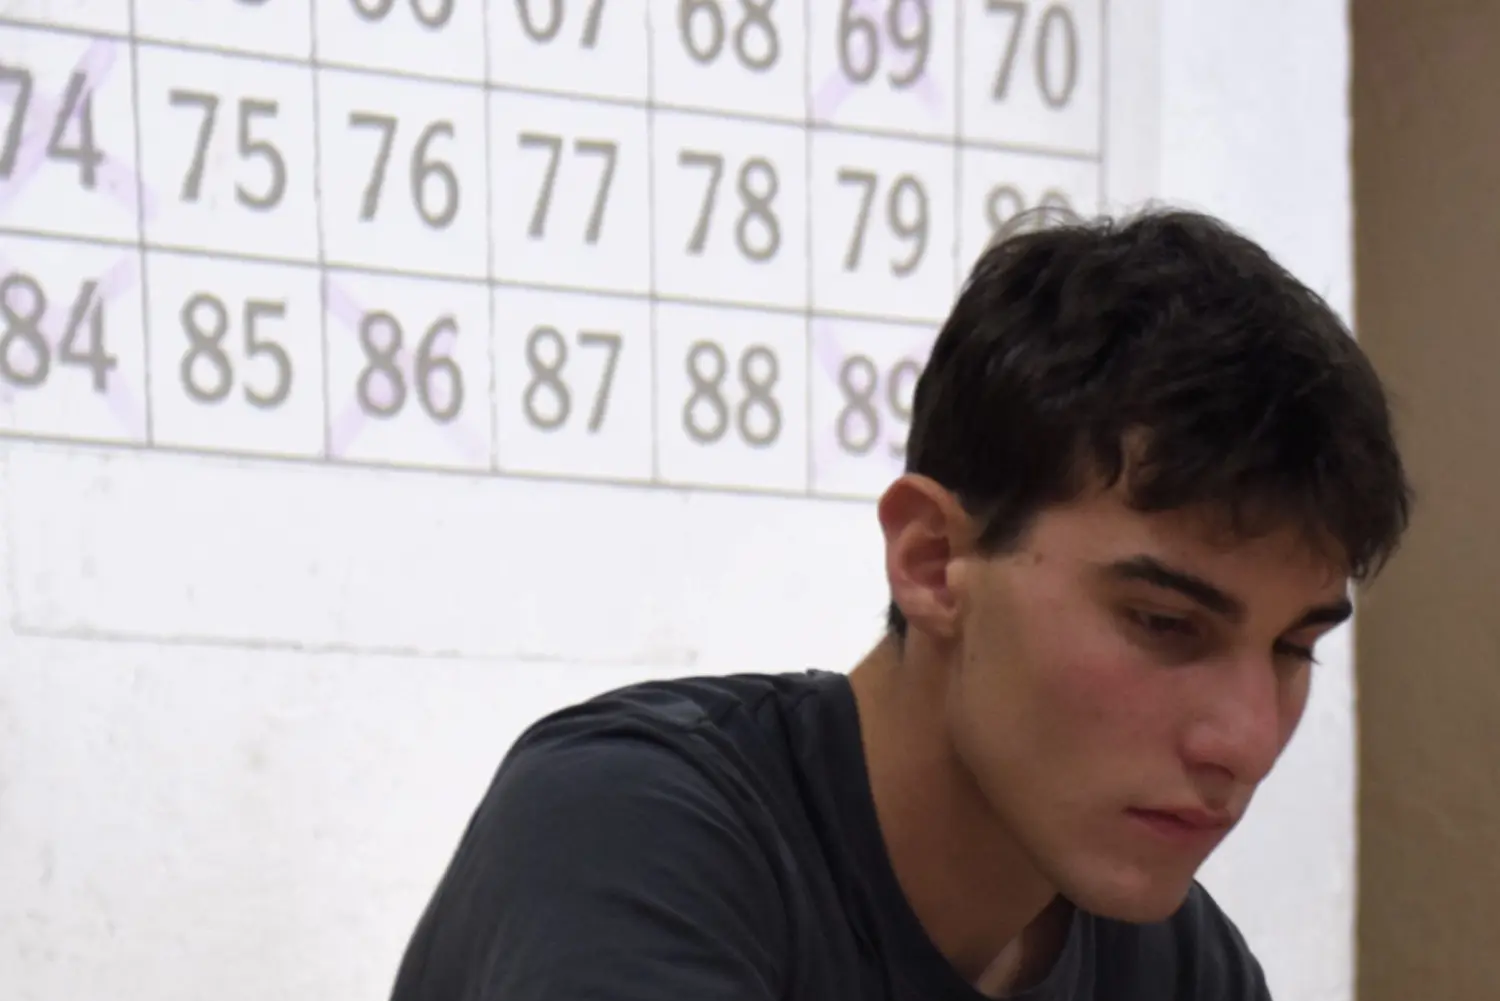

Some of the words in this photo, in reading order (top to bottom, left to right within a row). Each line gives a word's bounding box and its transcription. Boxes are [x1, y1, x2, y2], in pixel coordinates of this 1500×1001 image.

[677, 0, 781, 72] 68
[836, 0, 933, 90] 69
[984, 0, 1080, 110] 70
[0, 62, 107, 190] 74
[168, 89, 288, 212] 75
[348, 112, 460, 230] 76
[518, 133, 618, 244] 77
[678, 150, 782, 263] 78
[836, 167, 930, 278] 79
[0, 272, 117, 395] 84
[180, 293, 294, 410] 85
[356, 311, 465, 424] 86
[522, 325, 623, 434] 87
[682, 340, 783, 449] 88
